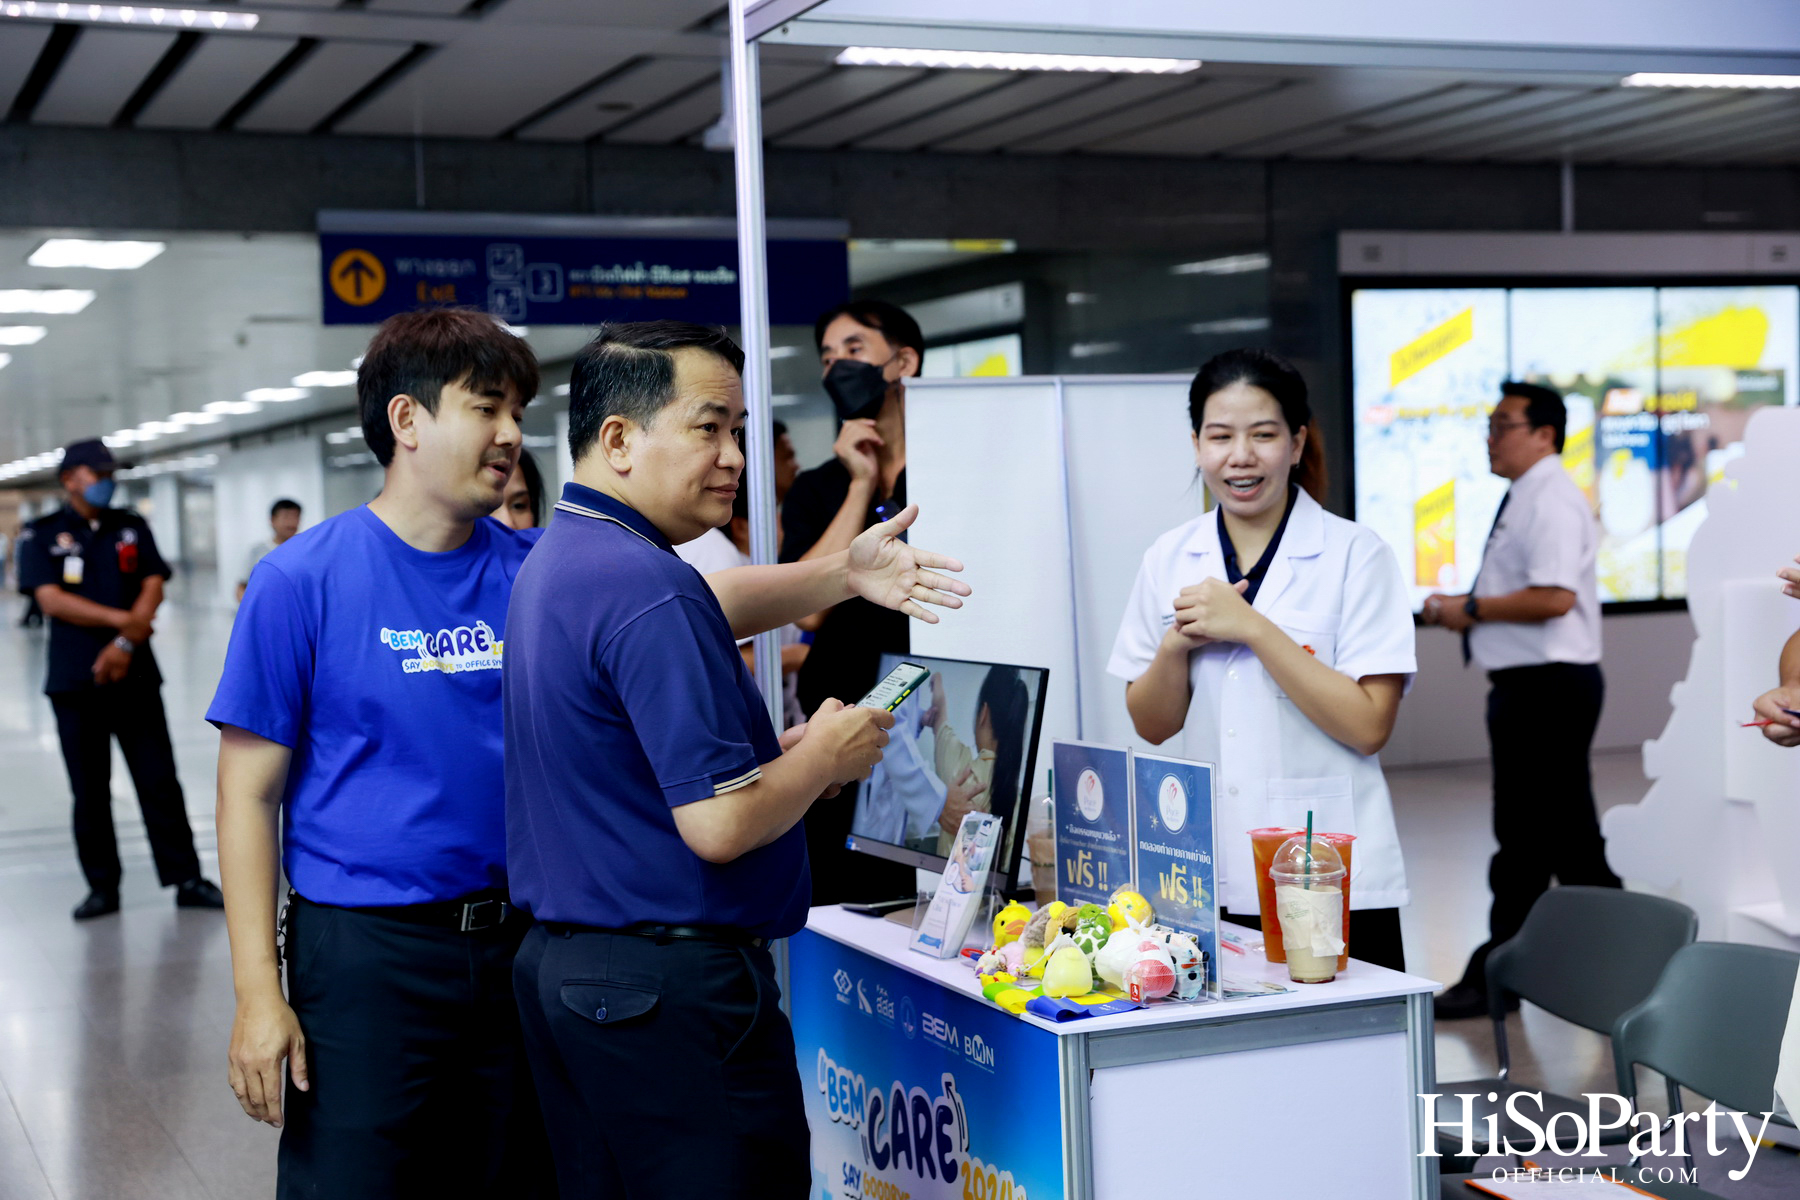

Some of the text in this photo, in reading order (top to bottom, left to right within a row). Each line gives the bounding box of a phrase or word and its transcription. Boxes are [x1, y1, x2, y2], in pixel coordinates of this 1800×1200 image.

[390, 632, 423, 648] BEM
[426, 629, 489, 658] CARE
[404, 661, 420, 671] SAY
[465, 659, 491, 669] OFFICE
[1066, 849, 1095, 888] ฟรี
[1159, 863, 1188, 905] ฟรี
[922, 1012, 959, 1048] BEM
[827, 1066, 866, 1124] BEM
[868, 1088, 959, 1184] CARE
[843, 1161, 862, 1191] SAY
